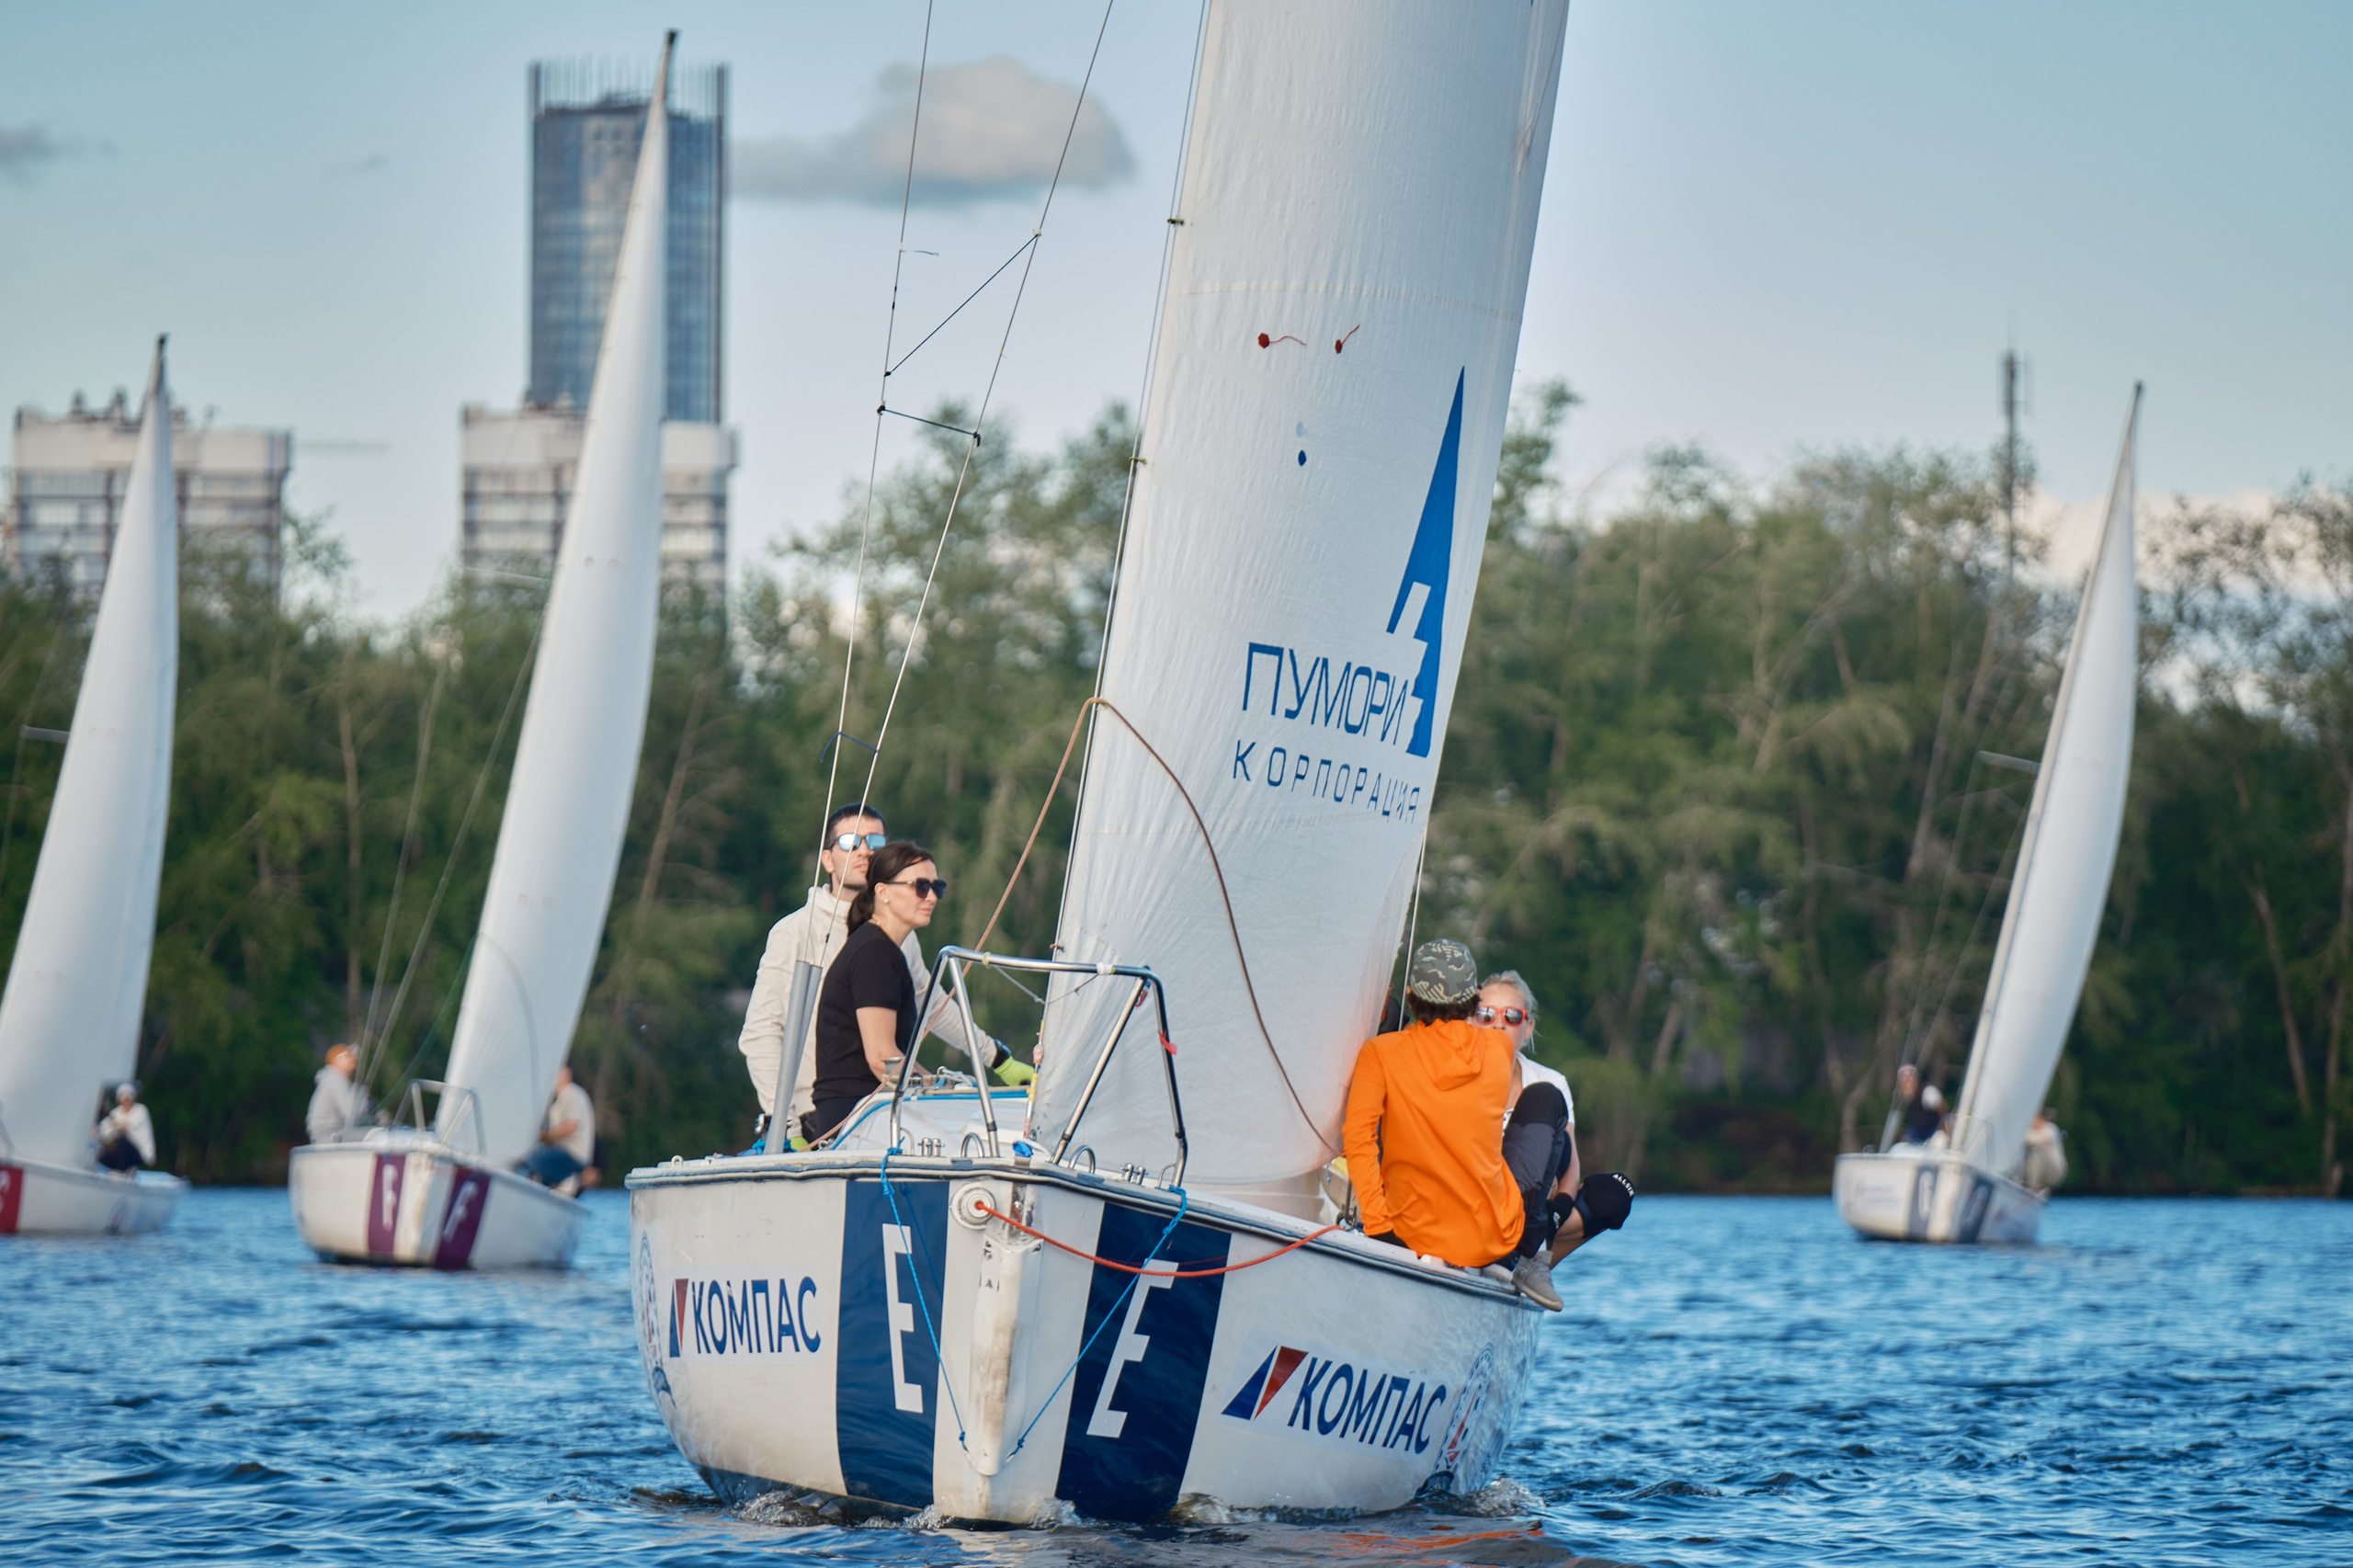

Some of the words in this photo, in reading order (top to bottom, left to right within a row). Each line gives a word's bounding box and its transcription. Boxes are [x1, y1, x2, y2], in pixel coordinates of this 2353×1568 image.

[1242, 642, 1408, 745] ПУМОРИ
[1233, 740, 1420, 824] КОРПОРАЦИЯ
[692, 1276, 821, 1354] КОМПАС
[1288, 1357, 1447, 1454] КОМПАС
